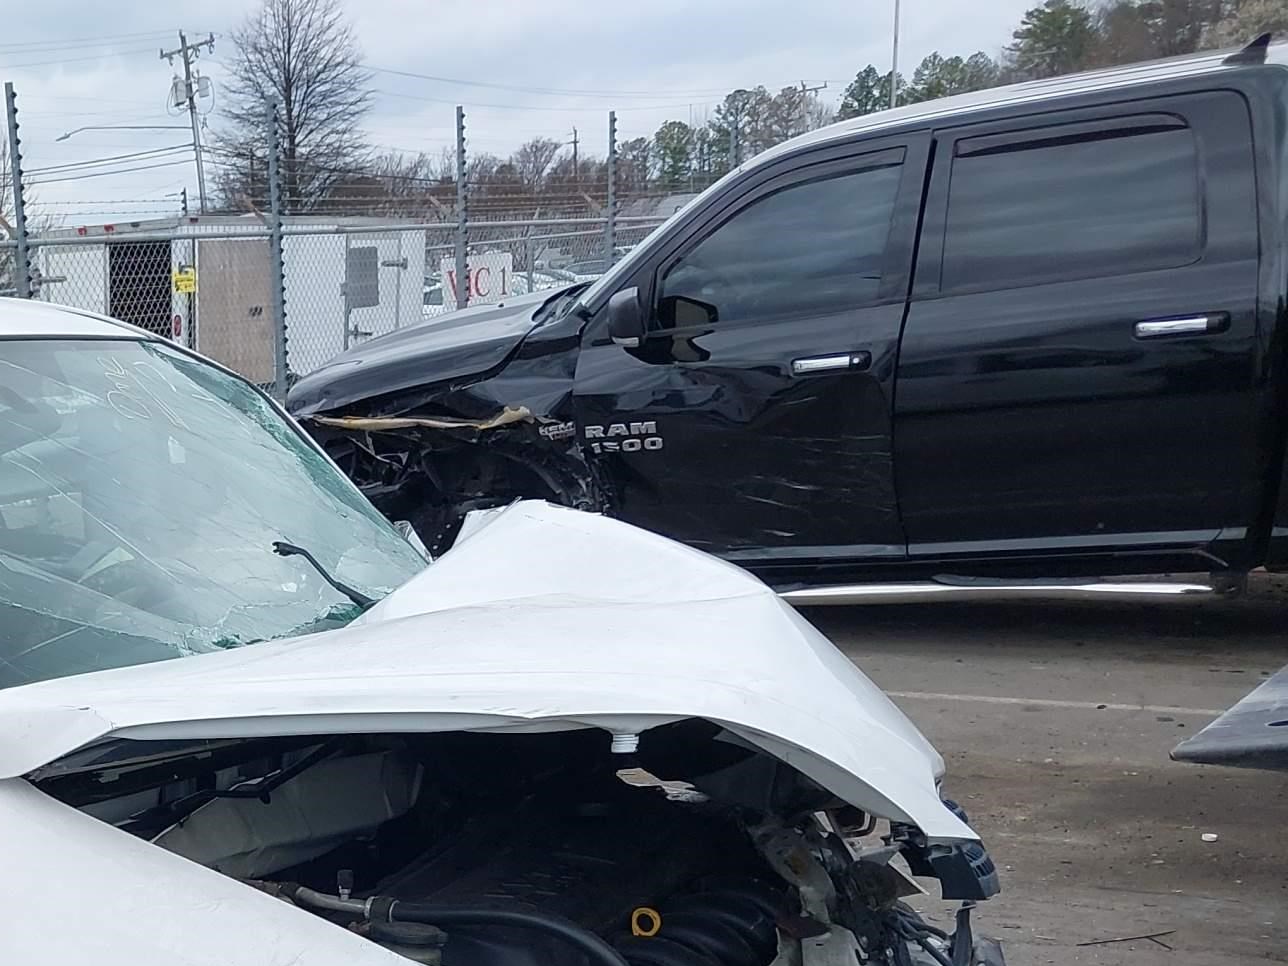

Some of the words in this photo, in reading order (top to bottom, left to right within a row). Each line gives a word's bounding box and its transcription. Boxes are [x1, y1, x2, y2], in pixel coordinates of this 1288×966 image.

[498, 266, 507, 296] 1
[584, 421, 657, 439] RAM
[591, 437, 663, 454] 1500
